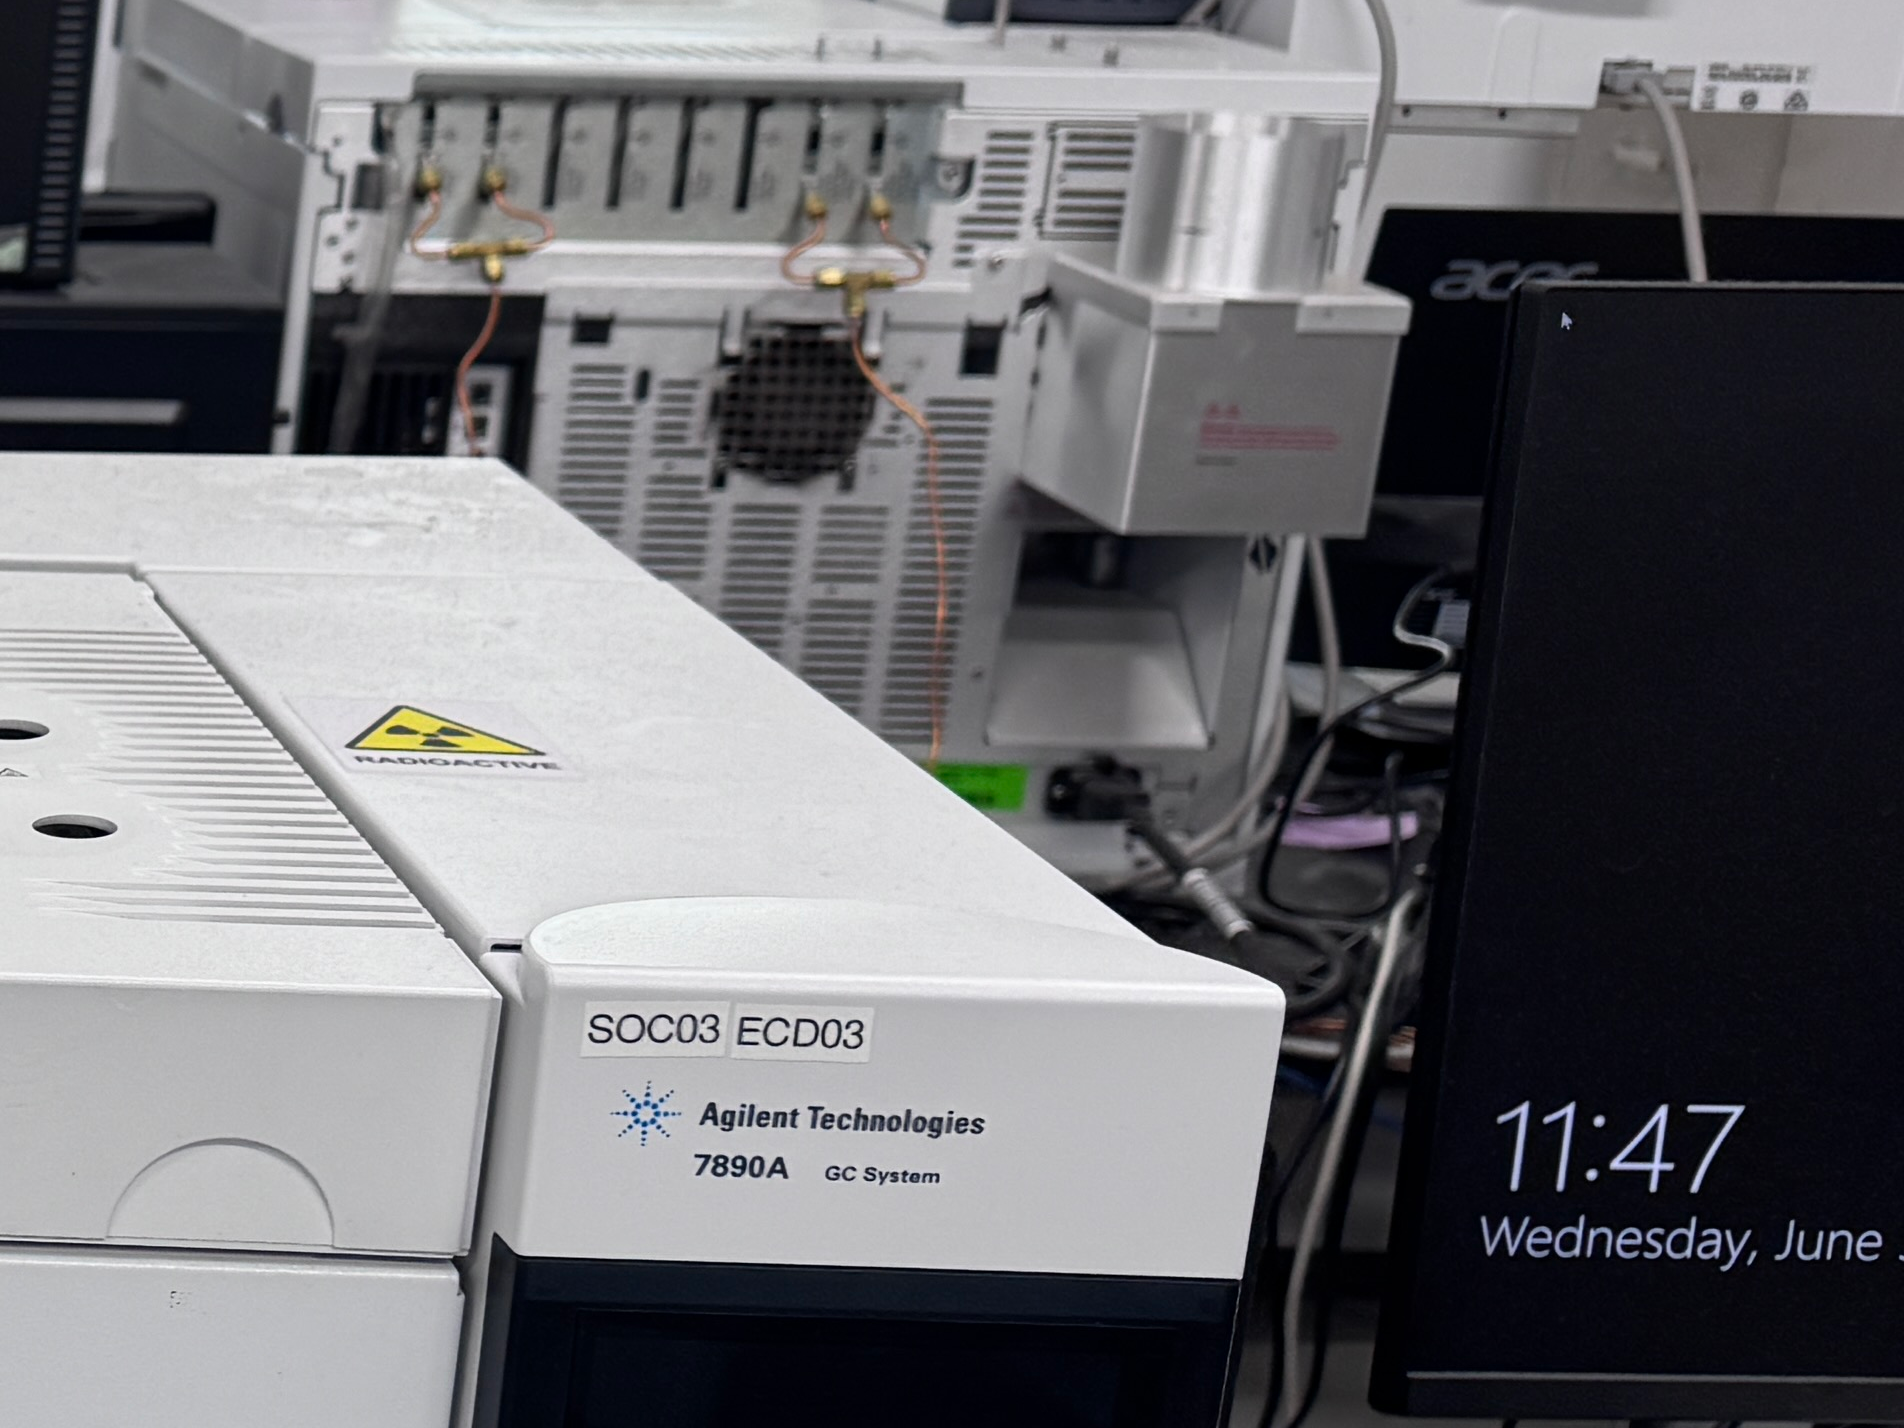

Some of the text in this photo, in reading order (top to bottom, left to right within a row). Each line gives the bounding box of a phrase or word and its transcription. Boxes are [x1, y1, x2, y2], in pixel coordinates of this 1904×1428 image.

[354, 755, 560, 770] RADIOACTIVE
[587, 1013, 865, 1050] SOC03 ECD03
[698, 1101, 986, 1140] Agilent Technologies
[1496, 1100, 1746, 1194] 11:47
[693, 1153, 941, 1186] 7890A GC System
[1480, 1214, 1883, 1272] Wednesday, June
